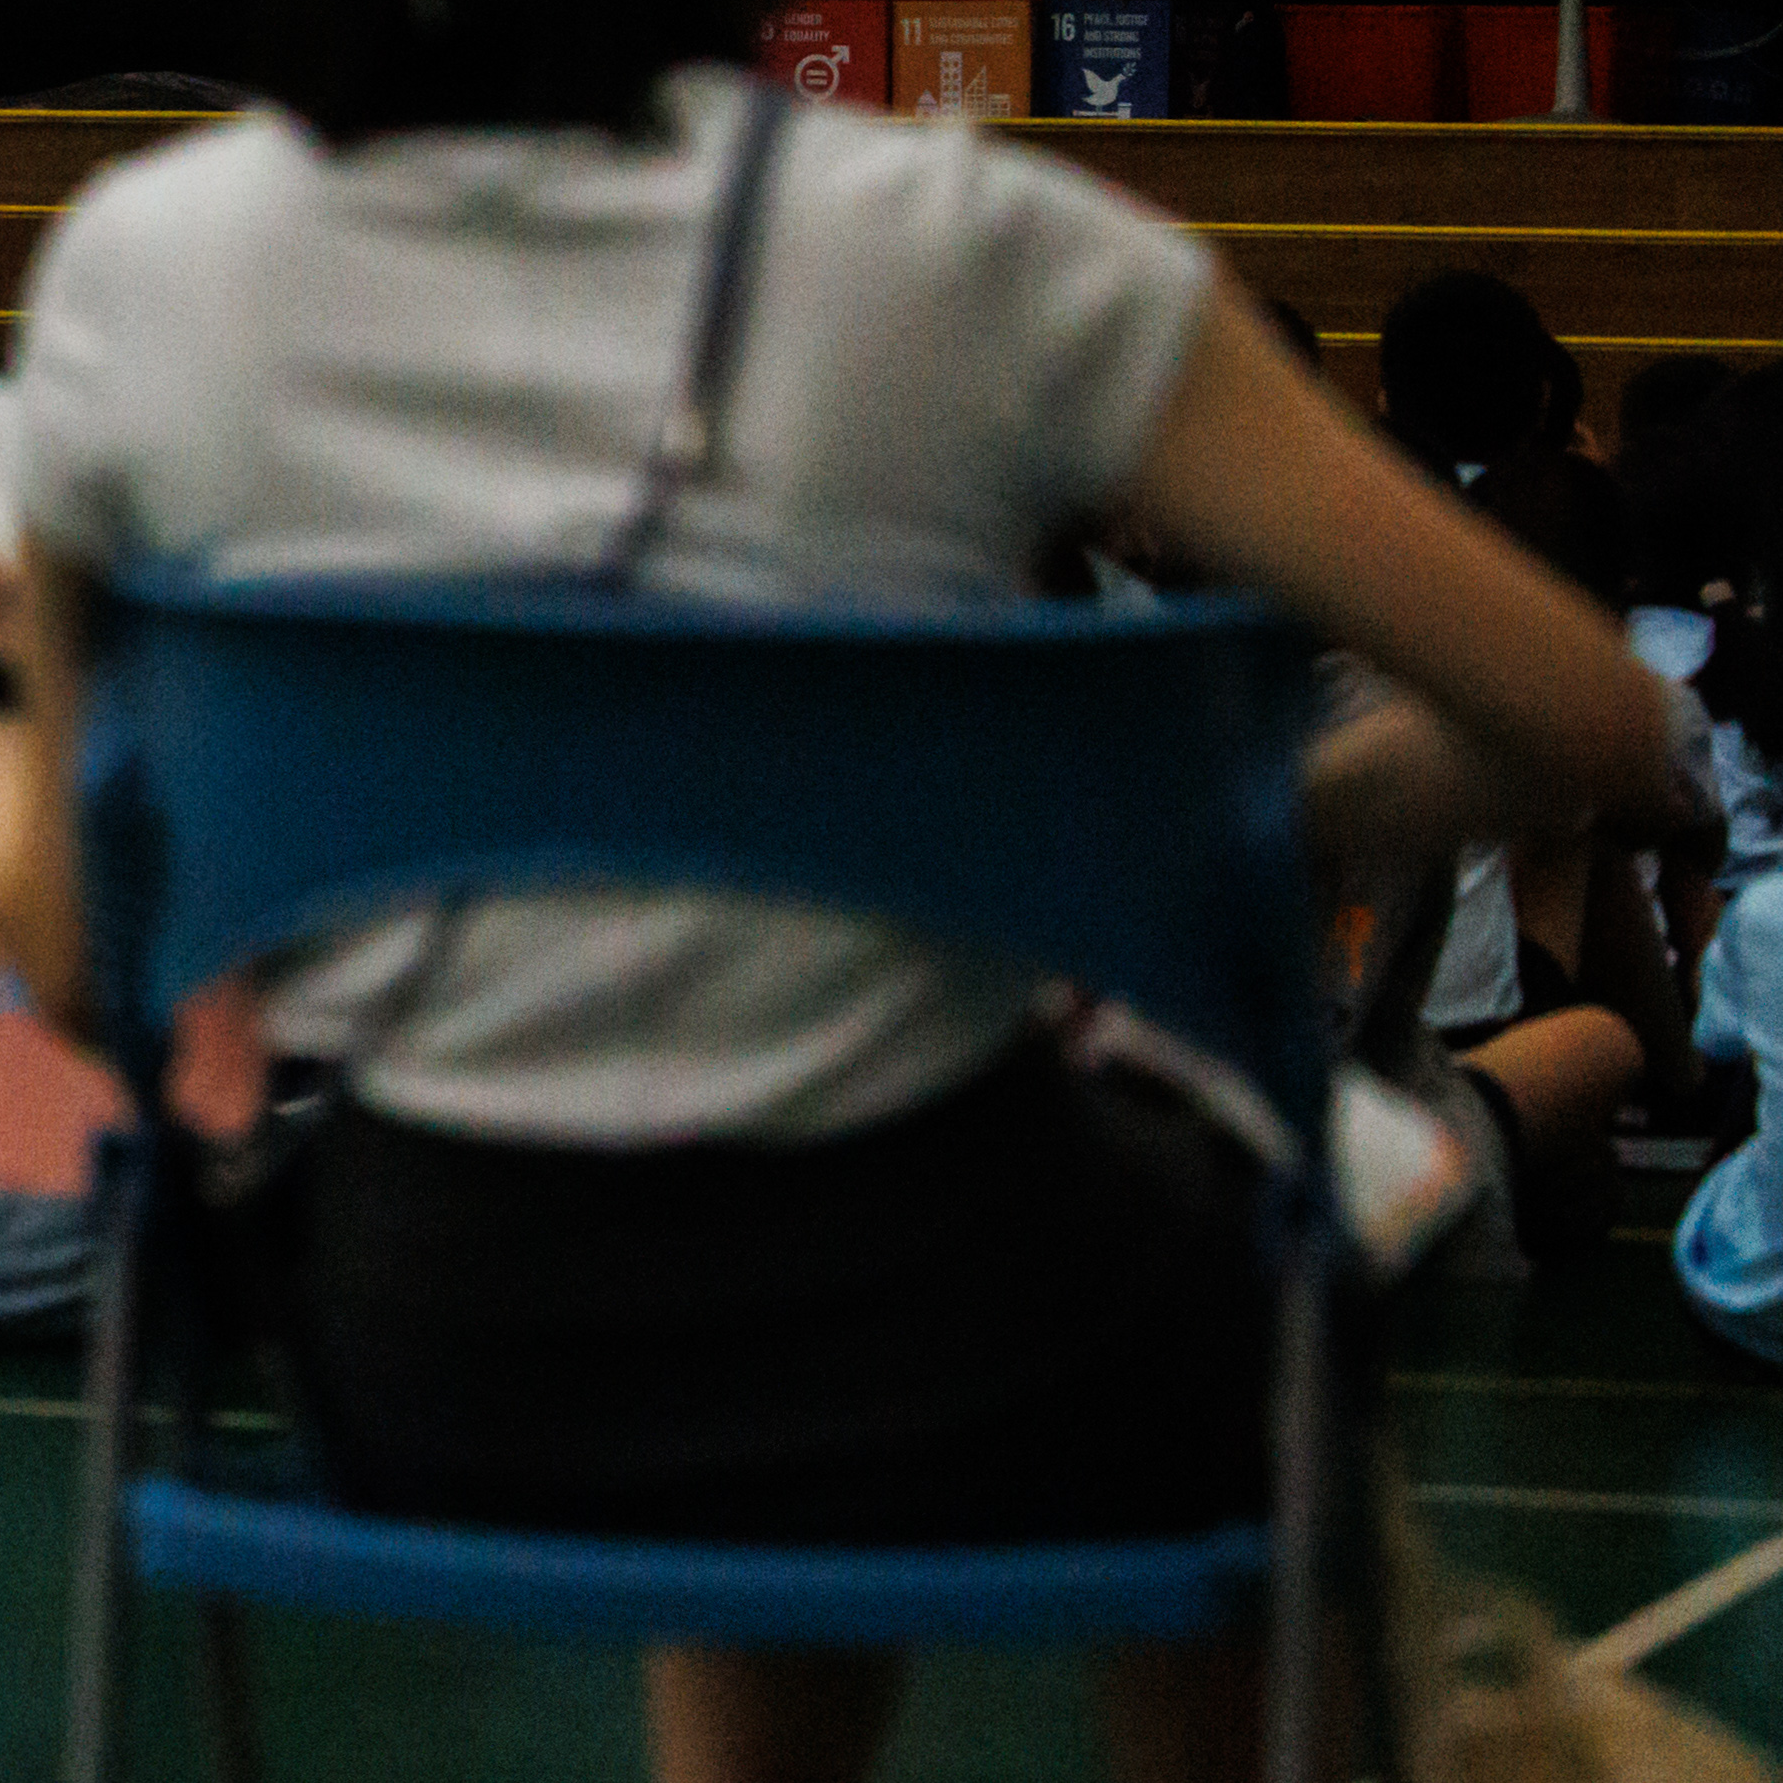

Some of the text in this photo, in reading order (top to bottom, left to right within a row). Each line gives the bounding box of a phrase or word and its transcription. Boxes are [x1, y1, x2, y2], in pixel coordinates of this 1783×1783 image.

[783, 29, 831, 43] EQUALITY
[900, 17, 922, 46] 11
[1050, 12, 1076, 42] 16
